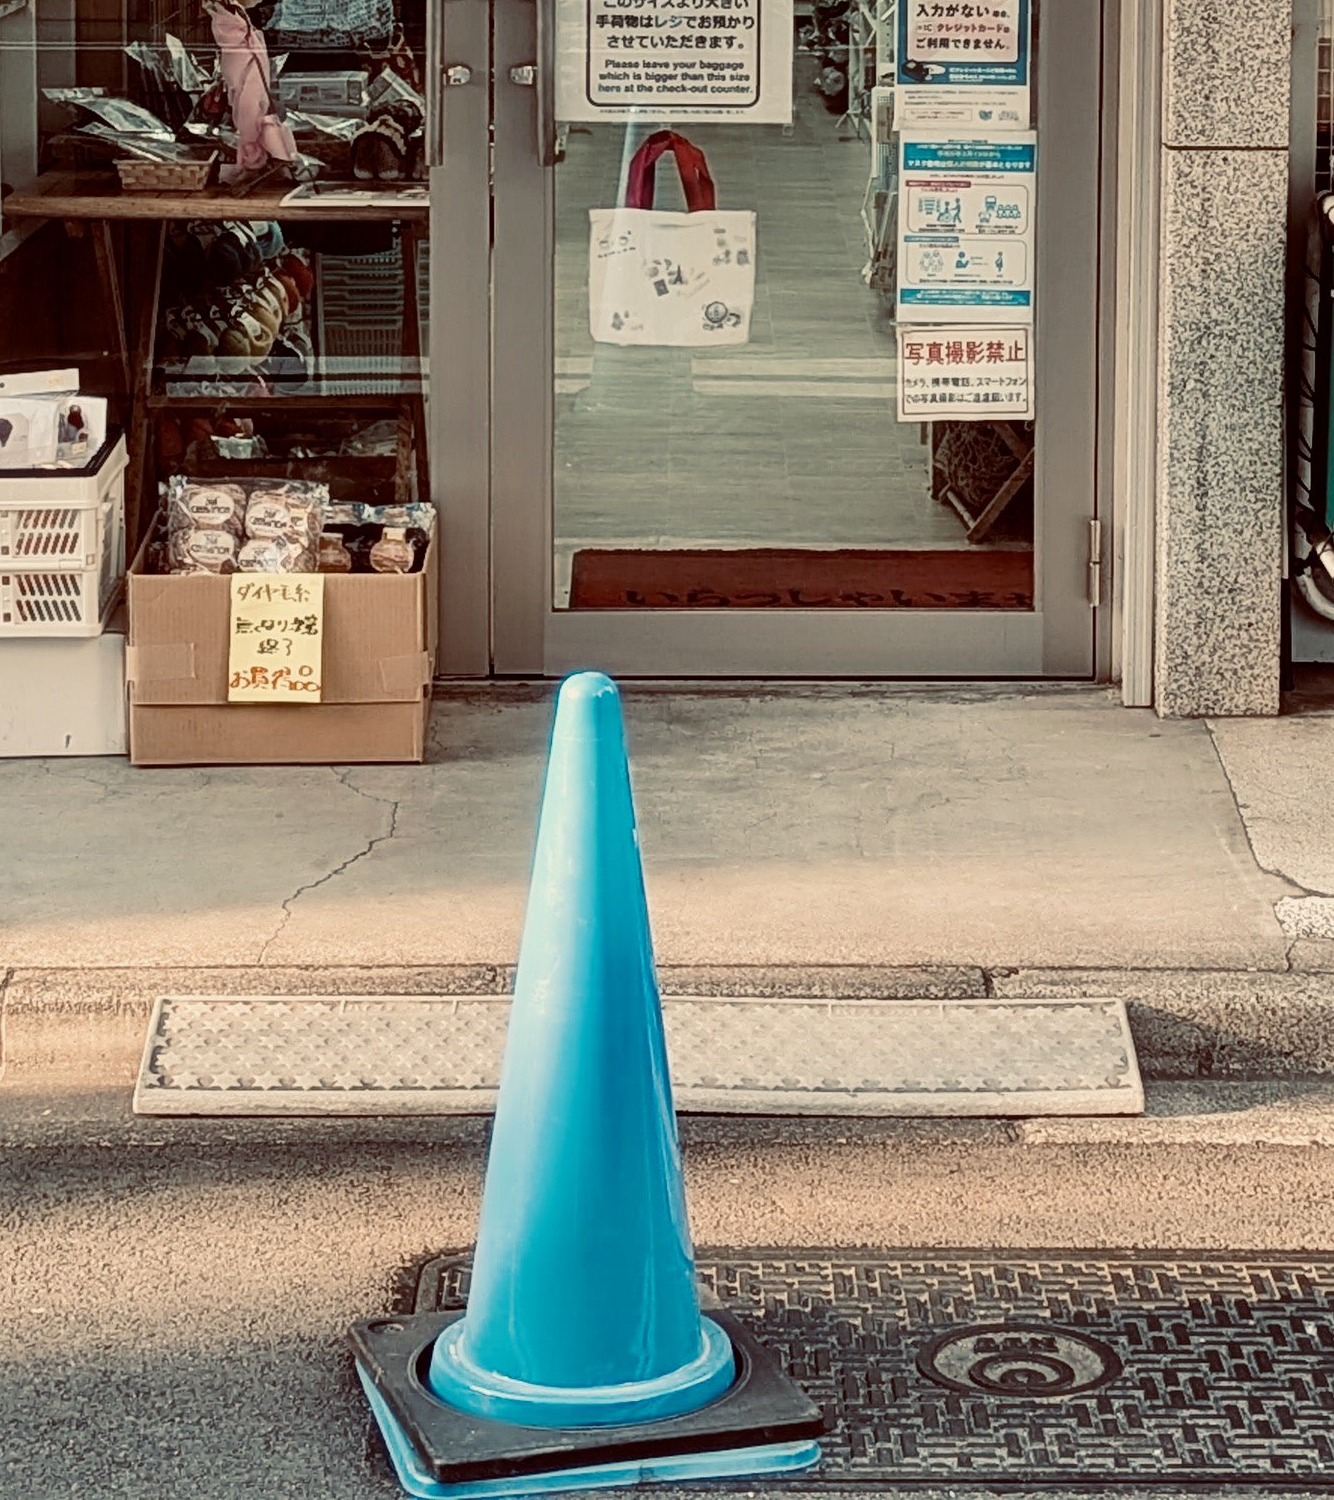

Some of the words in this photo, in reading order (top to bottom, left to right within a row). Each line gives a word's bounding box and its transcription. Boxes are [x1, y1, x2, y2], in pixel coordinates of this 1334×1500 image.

[596, 15, 755, 29] 手荷物はレジでお預かり
[607, 35, 745, 49] させていただきます。
[605, 59, 640, 69] Please
[642, 59, 670, 69] leave
[672, 62, 695, 71] your
[699, 60, 744, 71] baggage
[599, 71, 630, 81] which
[633, 71, 642, 81] is
[645, 71, 678, 84] bigger
[681, 72, 705, 82] than
[707, 72, 726, 82] this
[729, 73, 750, 82] size
[598, 83, 621, 93] here
[624, 84, 634, 93] at
[637, 83, 653, 93] the
[656, 83, 708, 94] check-out
[710, 84, 754, 94] counter.
[905, 340, 1026, 365] 写真撮影禁止
